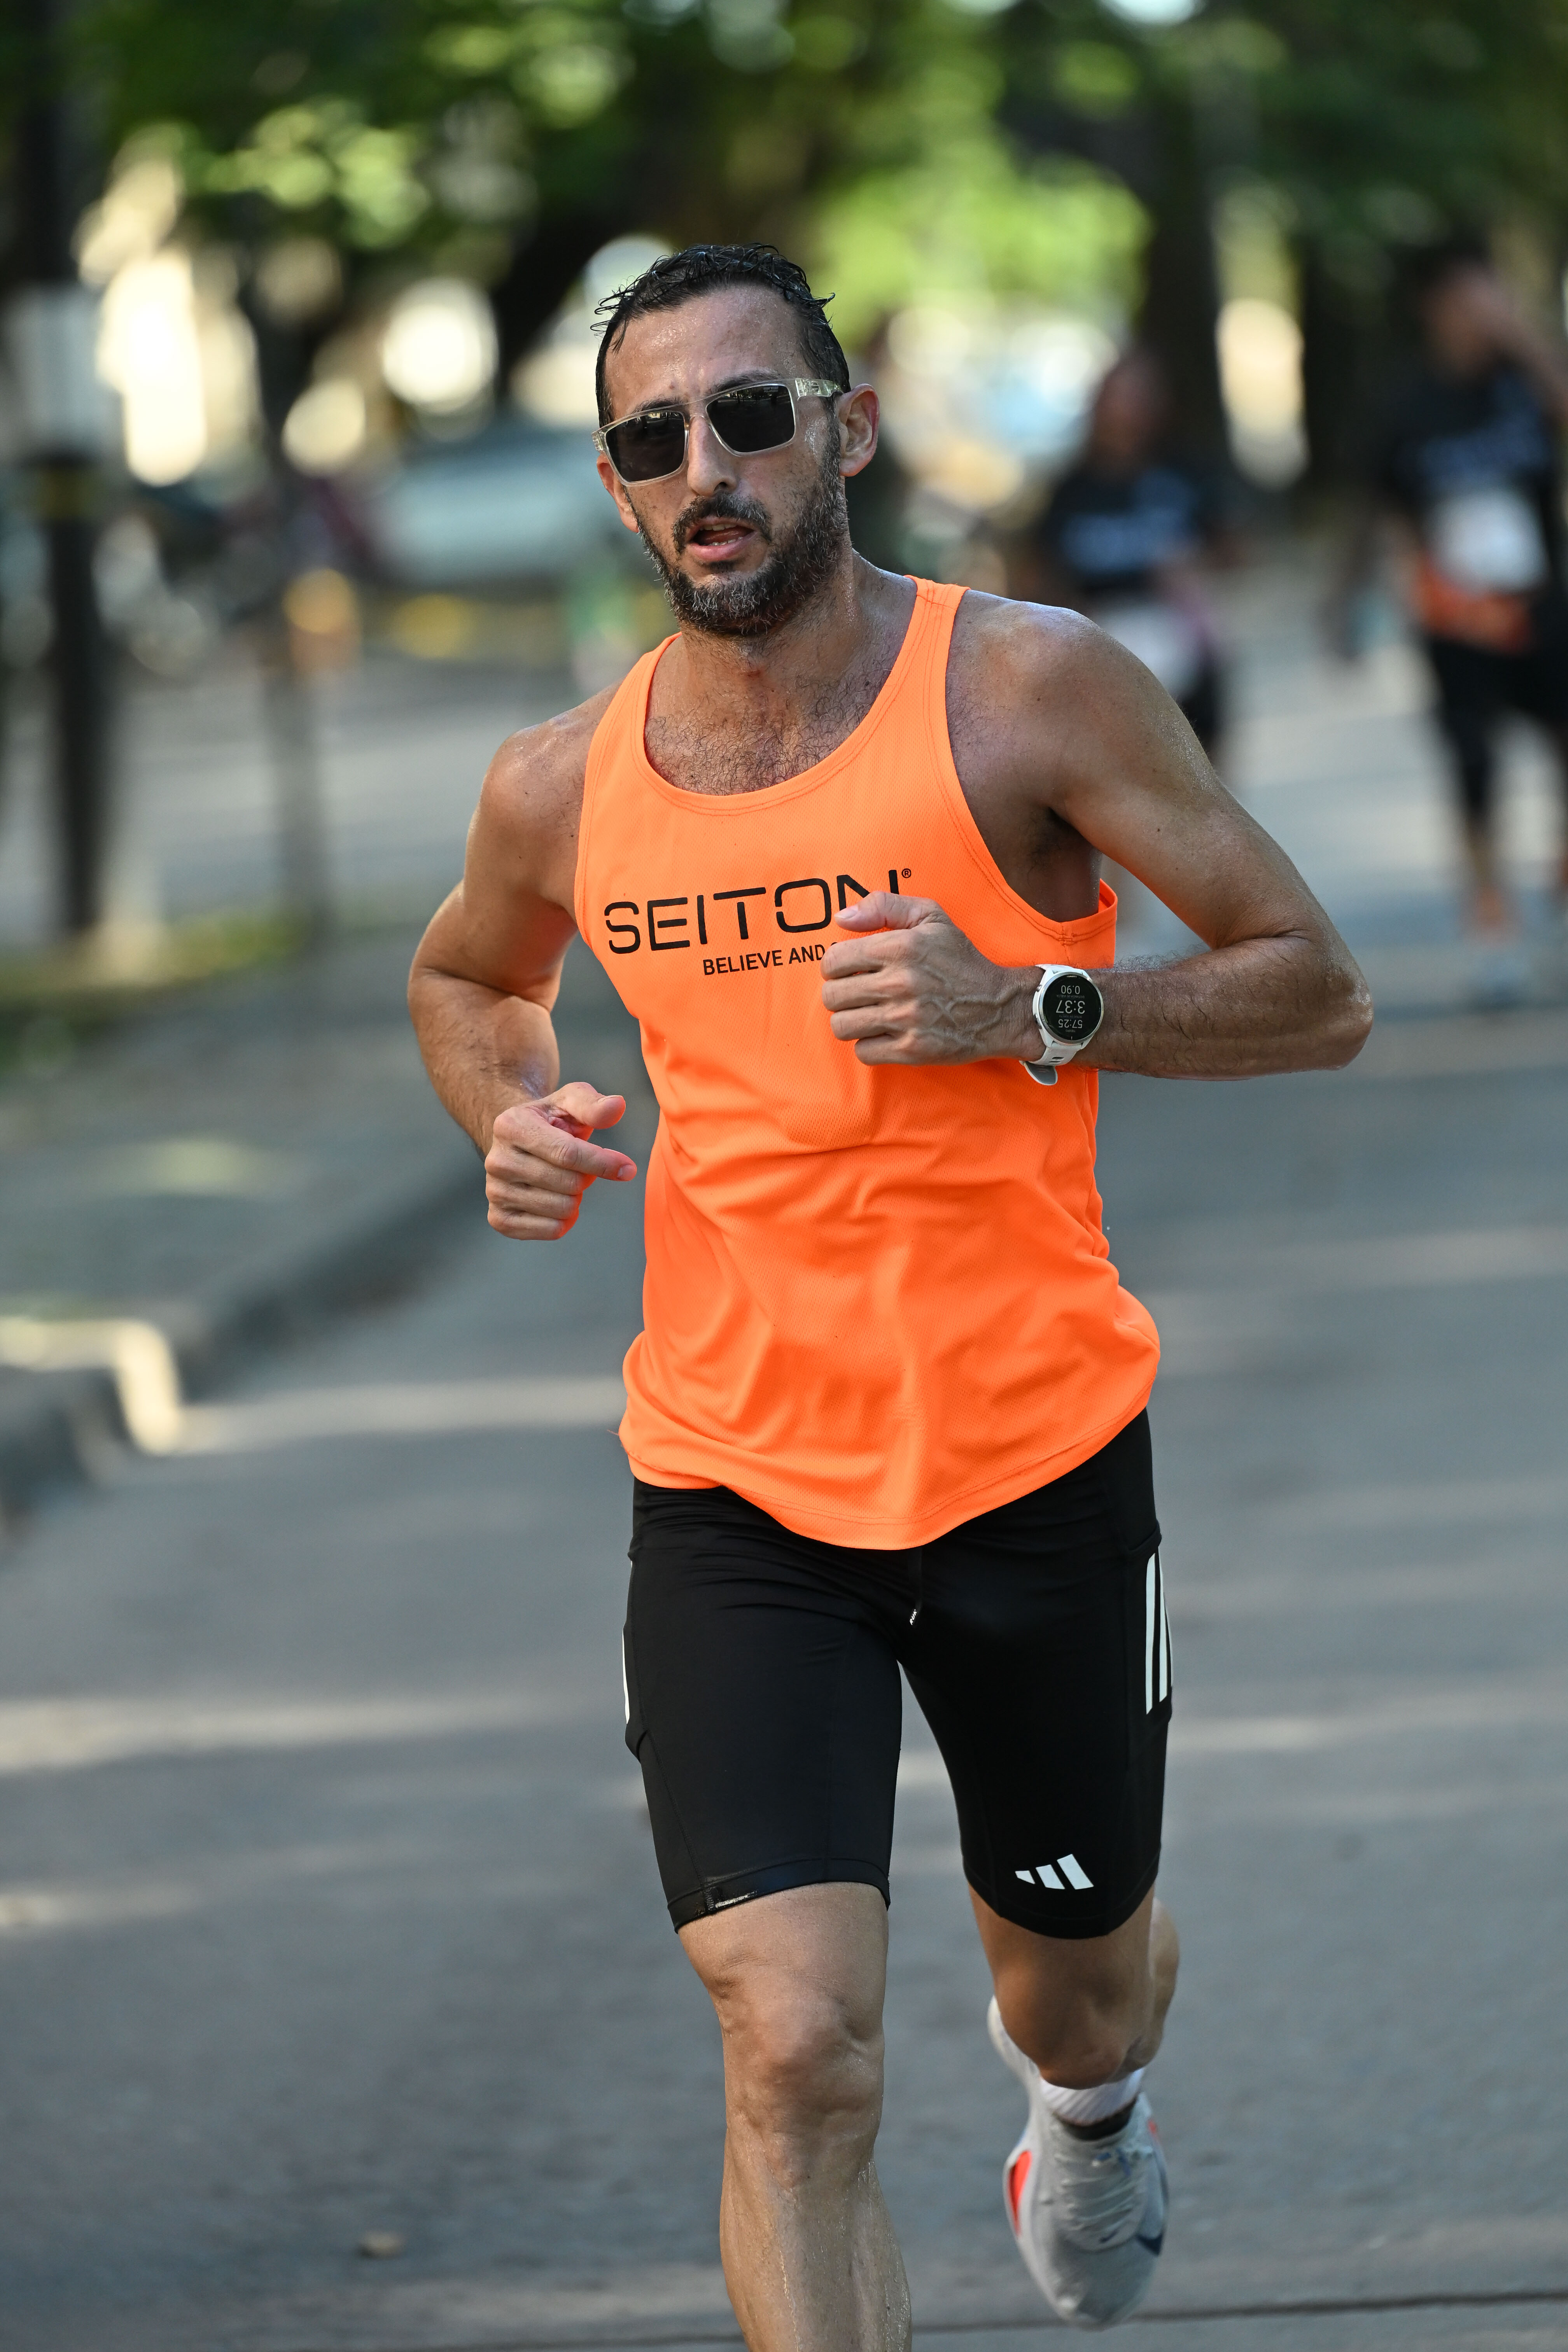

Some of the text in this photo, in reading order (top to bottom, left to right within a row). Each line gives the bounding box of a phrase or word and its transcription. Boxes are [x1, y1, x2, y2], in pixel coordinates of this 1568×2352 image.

[703, 944, 825, 975] BELIEVE AND
[1061, 985, 1080, 994] 0.90
[1056, 1000, 1085, 1014] 3:37
[1058, 1019, 1083, 1028] 57:25
